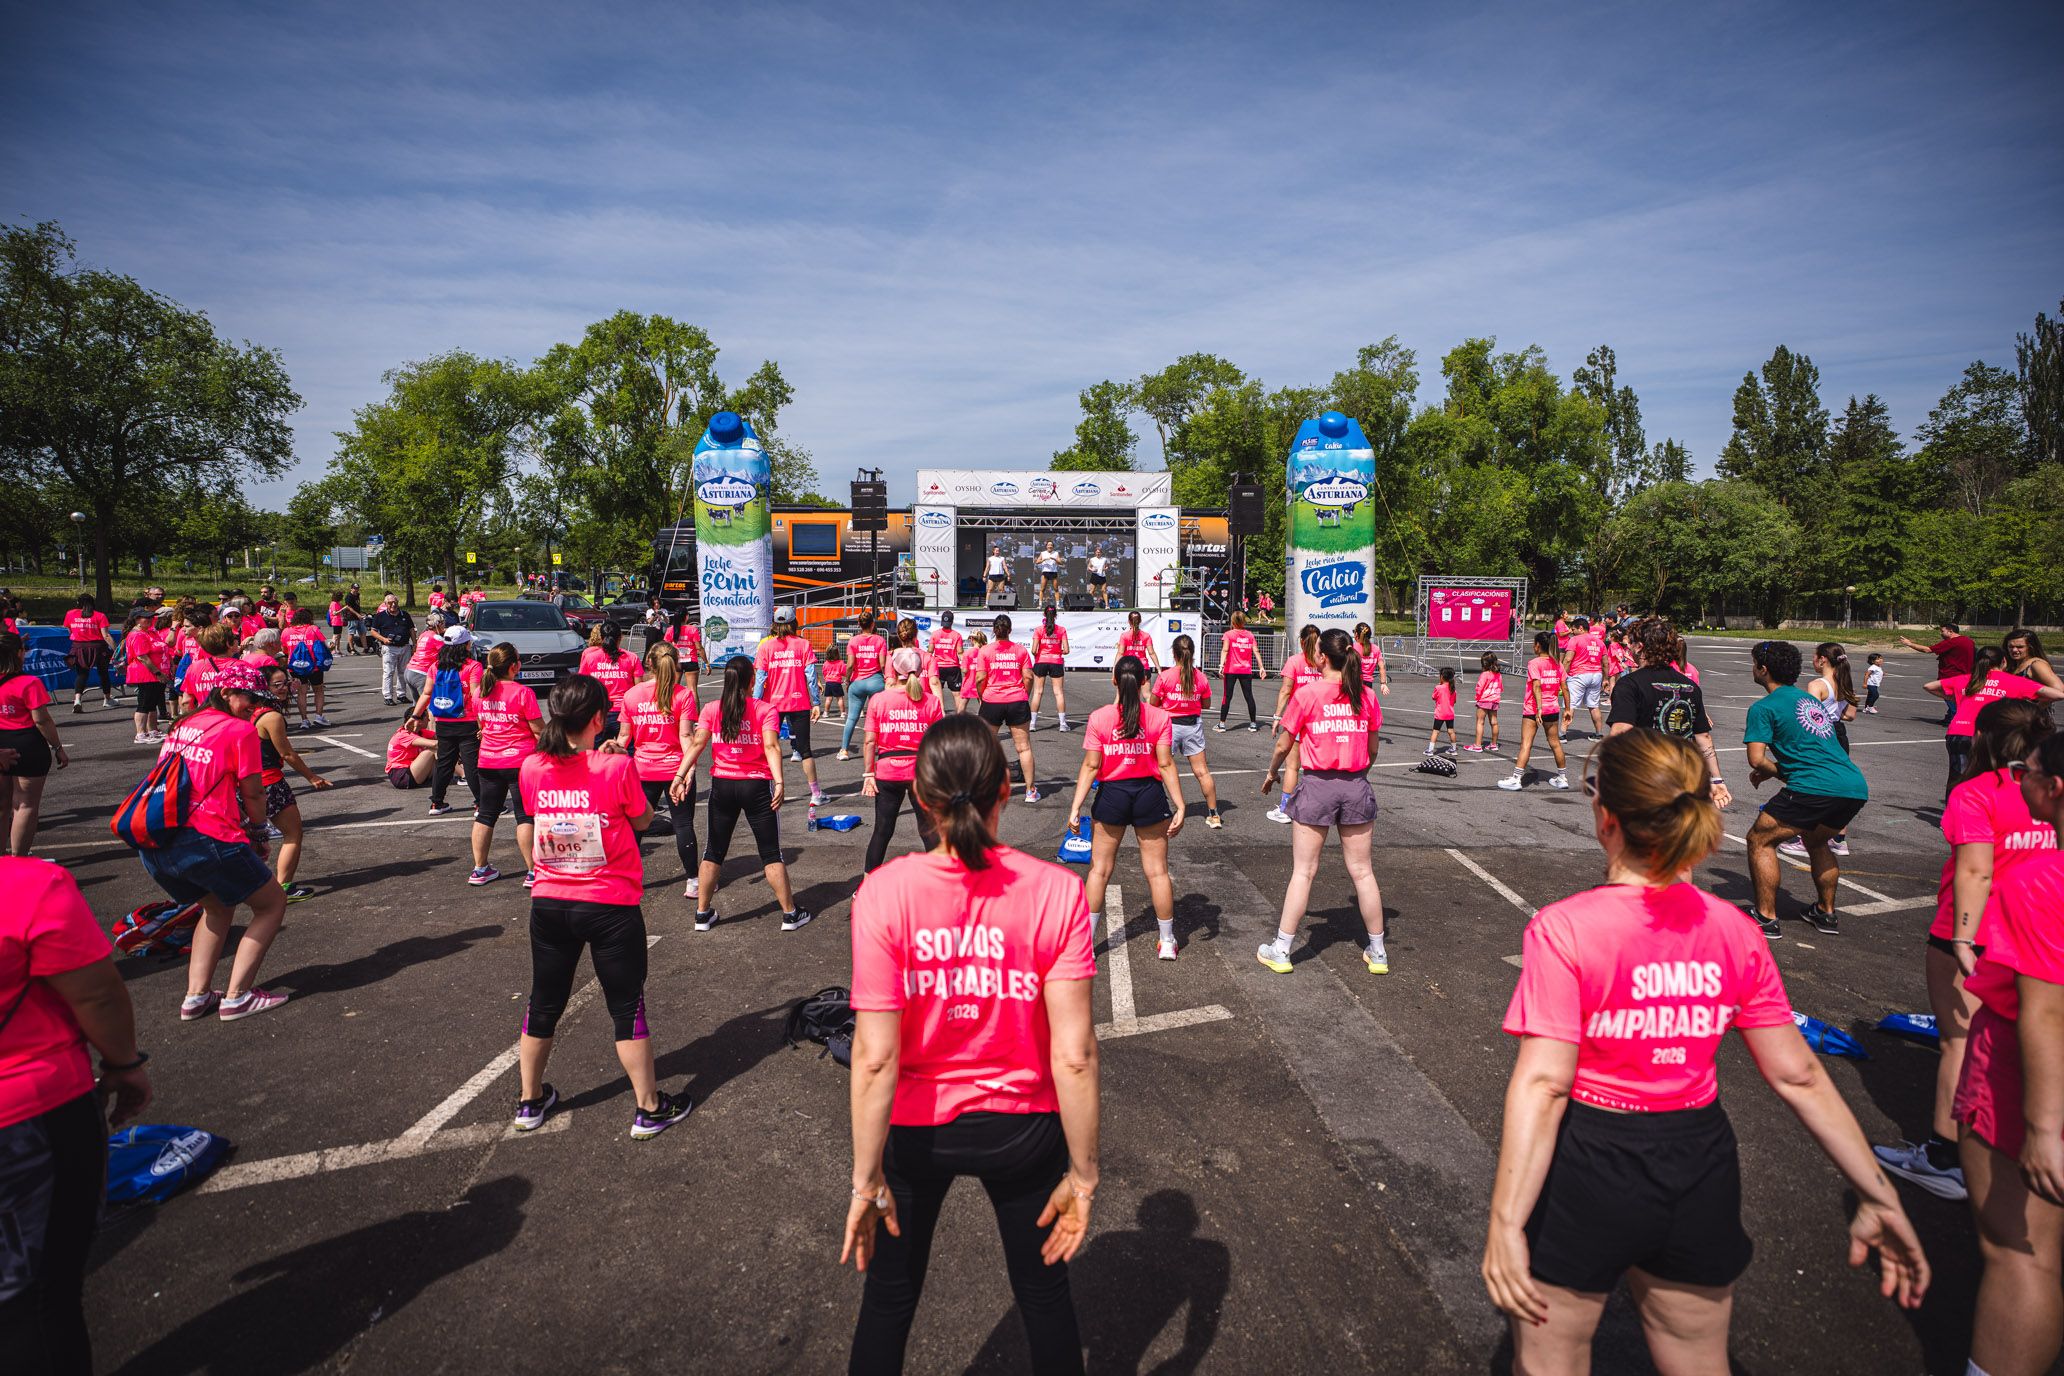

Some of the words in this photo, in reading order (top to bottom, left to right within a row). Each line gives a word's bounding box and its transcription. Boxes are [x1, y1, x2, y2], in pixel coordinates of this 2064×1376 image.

[700, 487, 753, 499] ASTURIANA
[1307, 489, 1363, 500] ASTURIANA
[921, 517, 949, 525] ASTURIANA
[920, 545, 950, 553] OYSHO
[1142, 547, 1174, 555] OYSHO
[704, 555, 732, 573] Leche
[702, 568, 759, 593] semi
[1306, 568, 1359, 594] Calcio
[703, 591, 761, 607] desnatada
[1329, 591, 1358, 604] natural
[1308, 611, 1358, 620] semidesnatada
[774, 650, 795, 659] SOMOS
[996, 653, 1016, 661] SOMOS
[482, 700, 507, 711] SOMOS
[1323, 703, 1353, 718] SOMO
[889, 709, 918, 721] SOMOS
[537, 789, 590, 809] SOMOS
[916, 924, 1005, 962] SOMOS
[1631, 961, 1722, 1001] SOMOS
[1652, 1046, 1687, 1065] 2026
